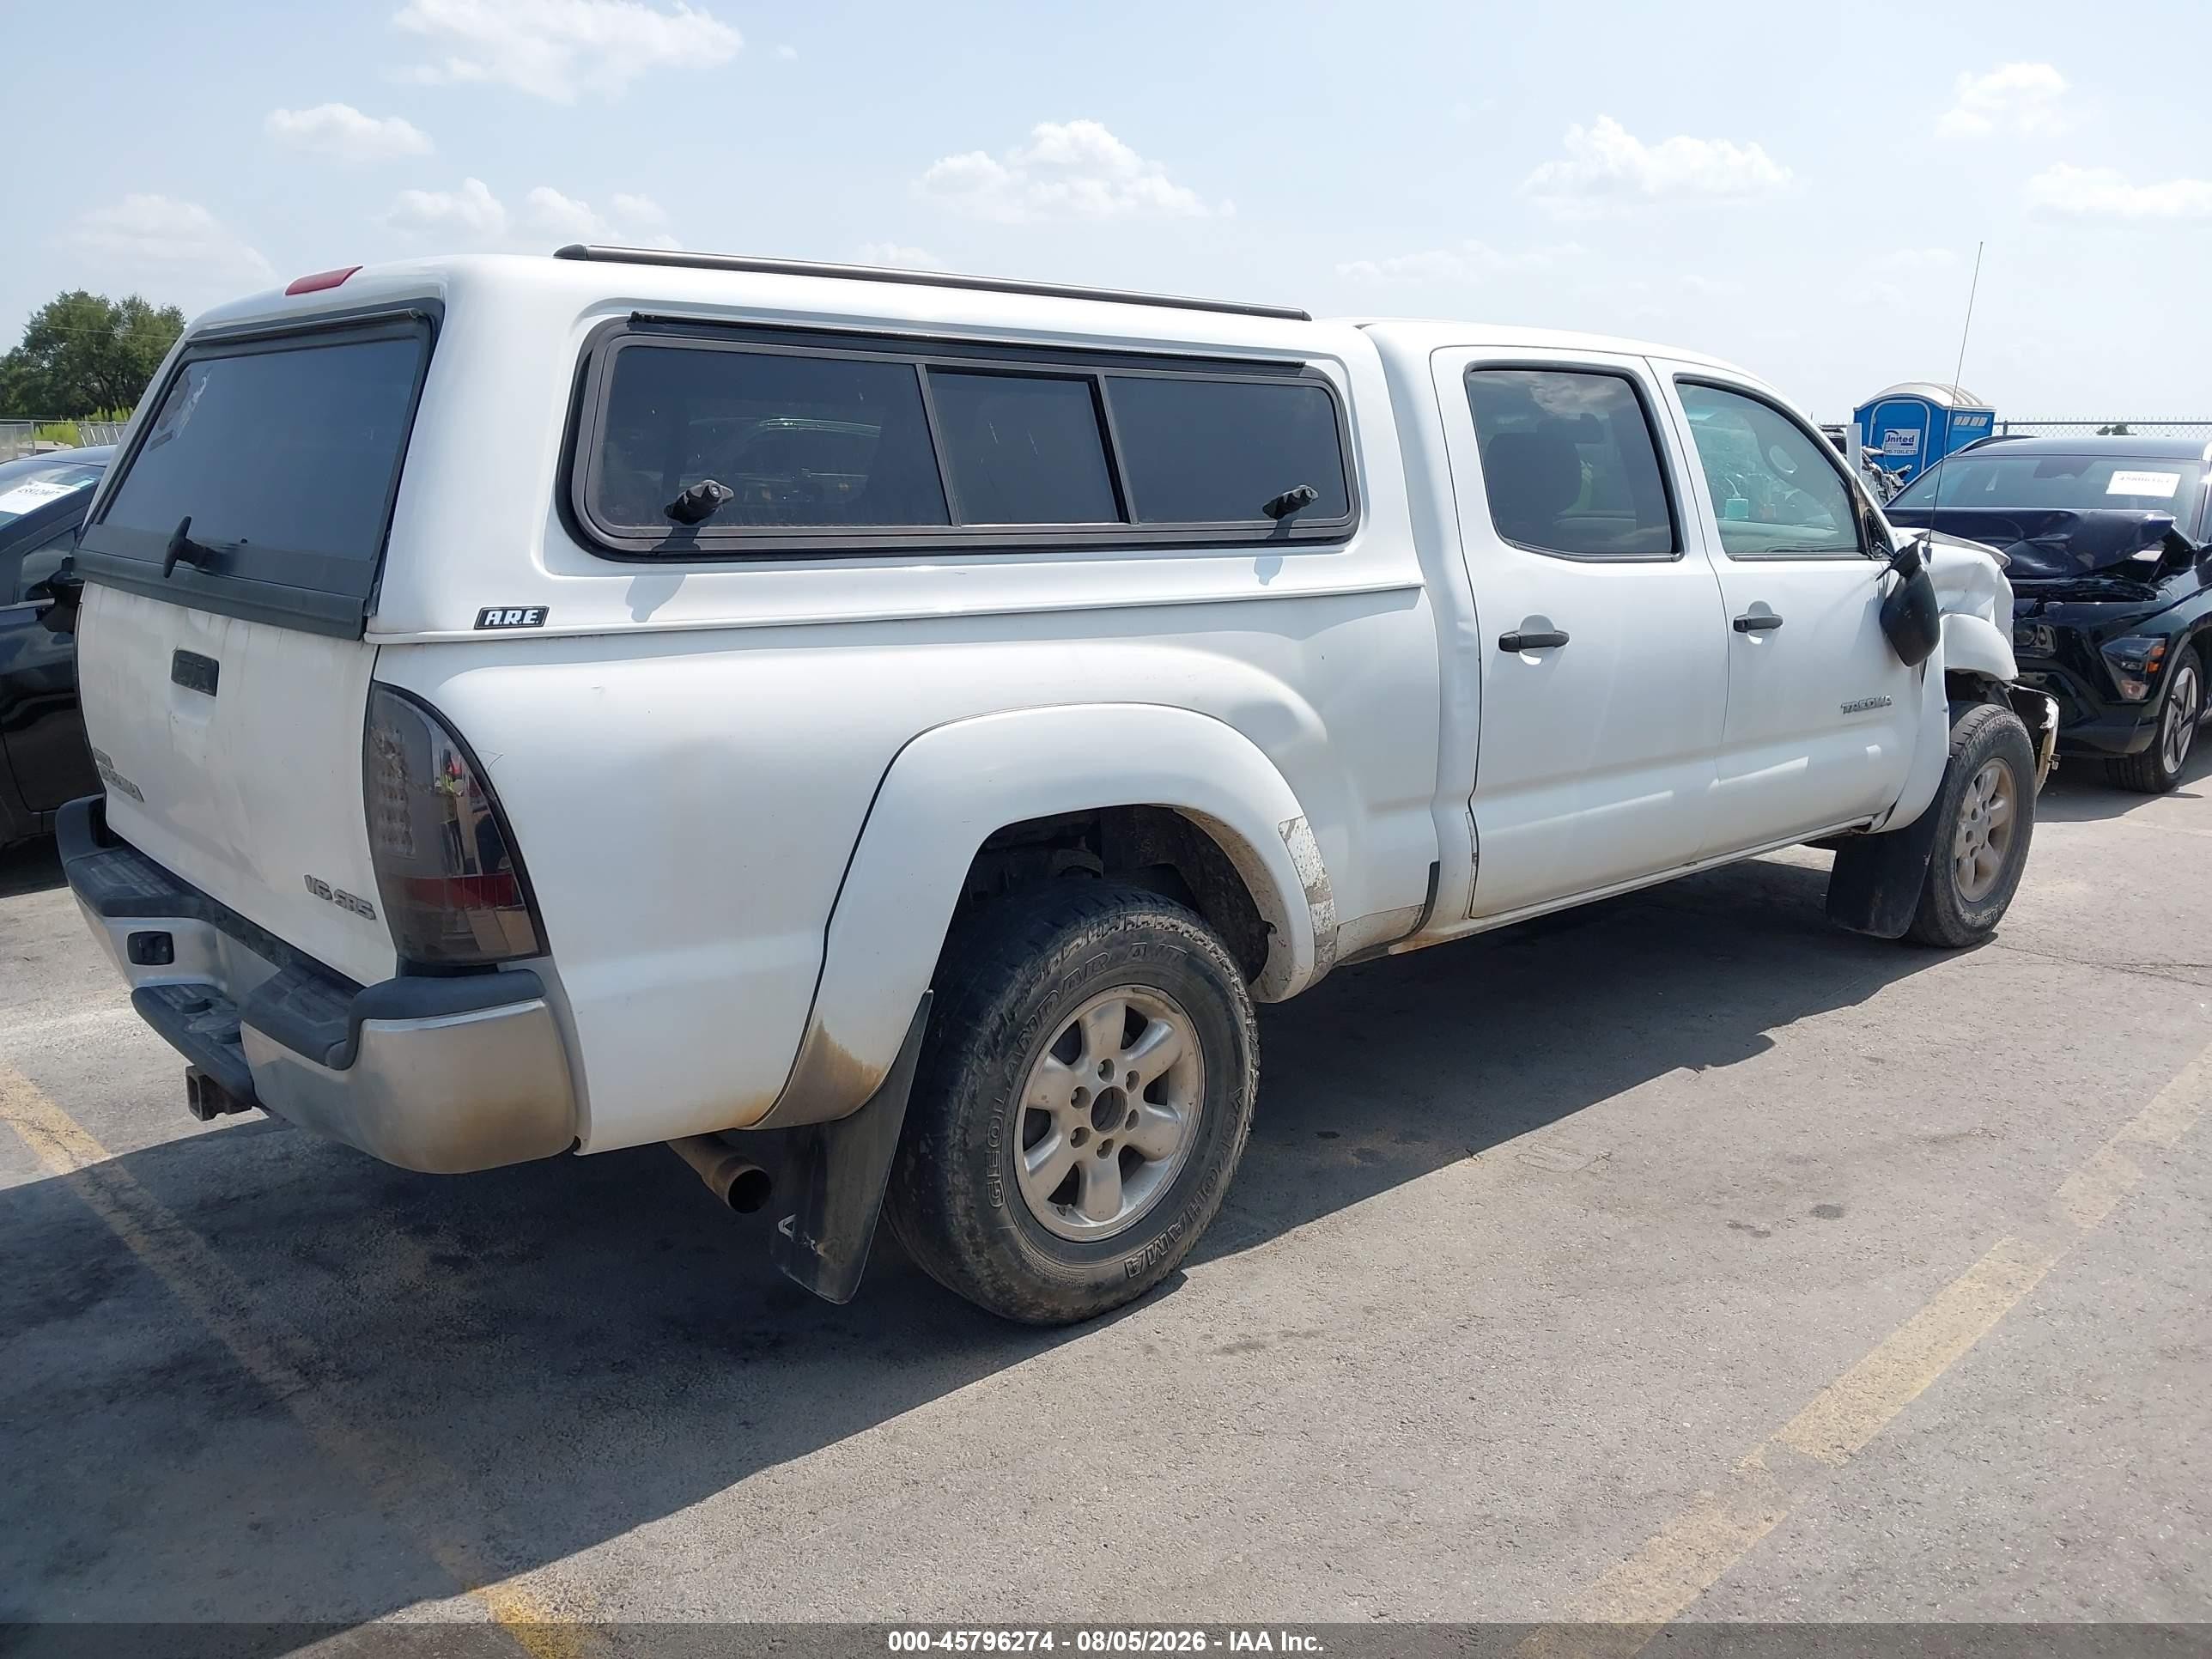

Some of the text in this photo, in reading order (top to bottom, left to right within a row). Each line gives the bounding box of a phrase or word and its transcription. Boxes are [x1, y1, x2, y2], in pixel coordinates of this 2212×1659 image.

[1840, 695, 1893, 714] TACOMA
[303, 874, 377, 921] V6 SR5
